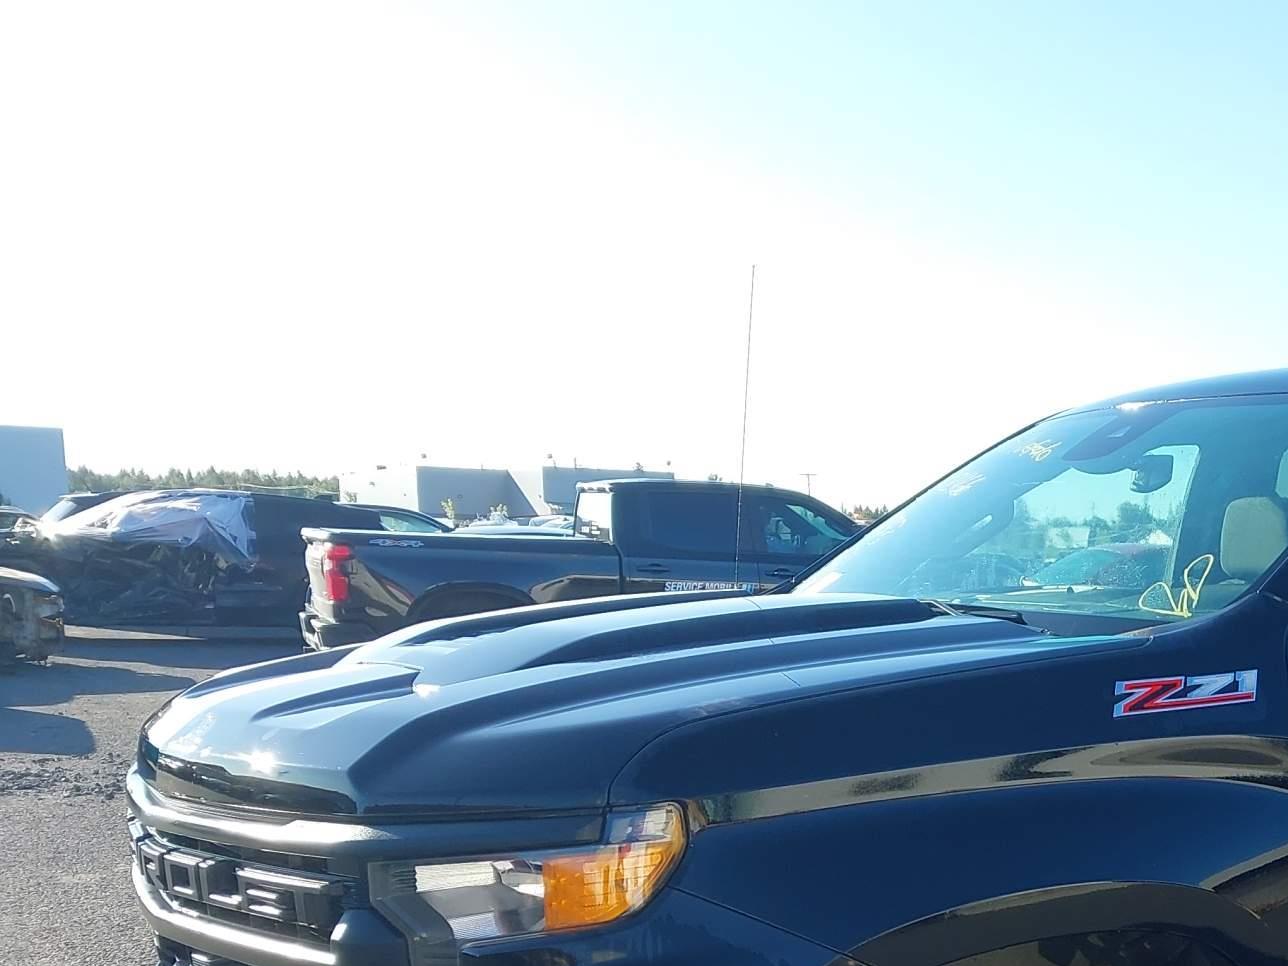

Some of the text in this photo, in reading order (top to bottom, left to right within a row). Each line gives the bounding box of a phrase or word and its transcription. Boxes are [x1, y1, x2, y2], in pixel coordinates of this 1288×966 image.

[664, 581, 704, 592] SERVICE
[1113, 669, 1258, 718] Z71
[130, 837, 344, 935] ROLET
